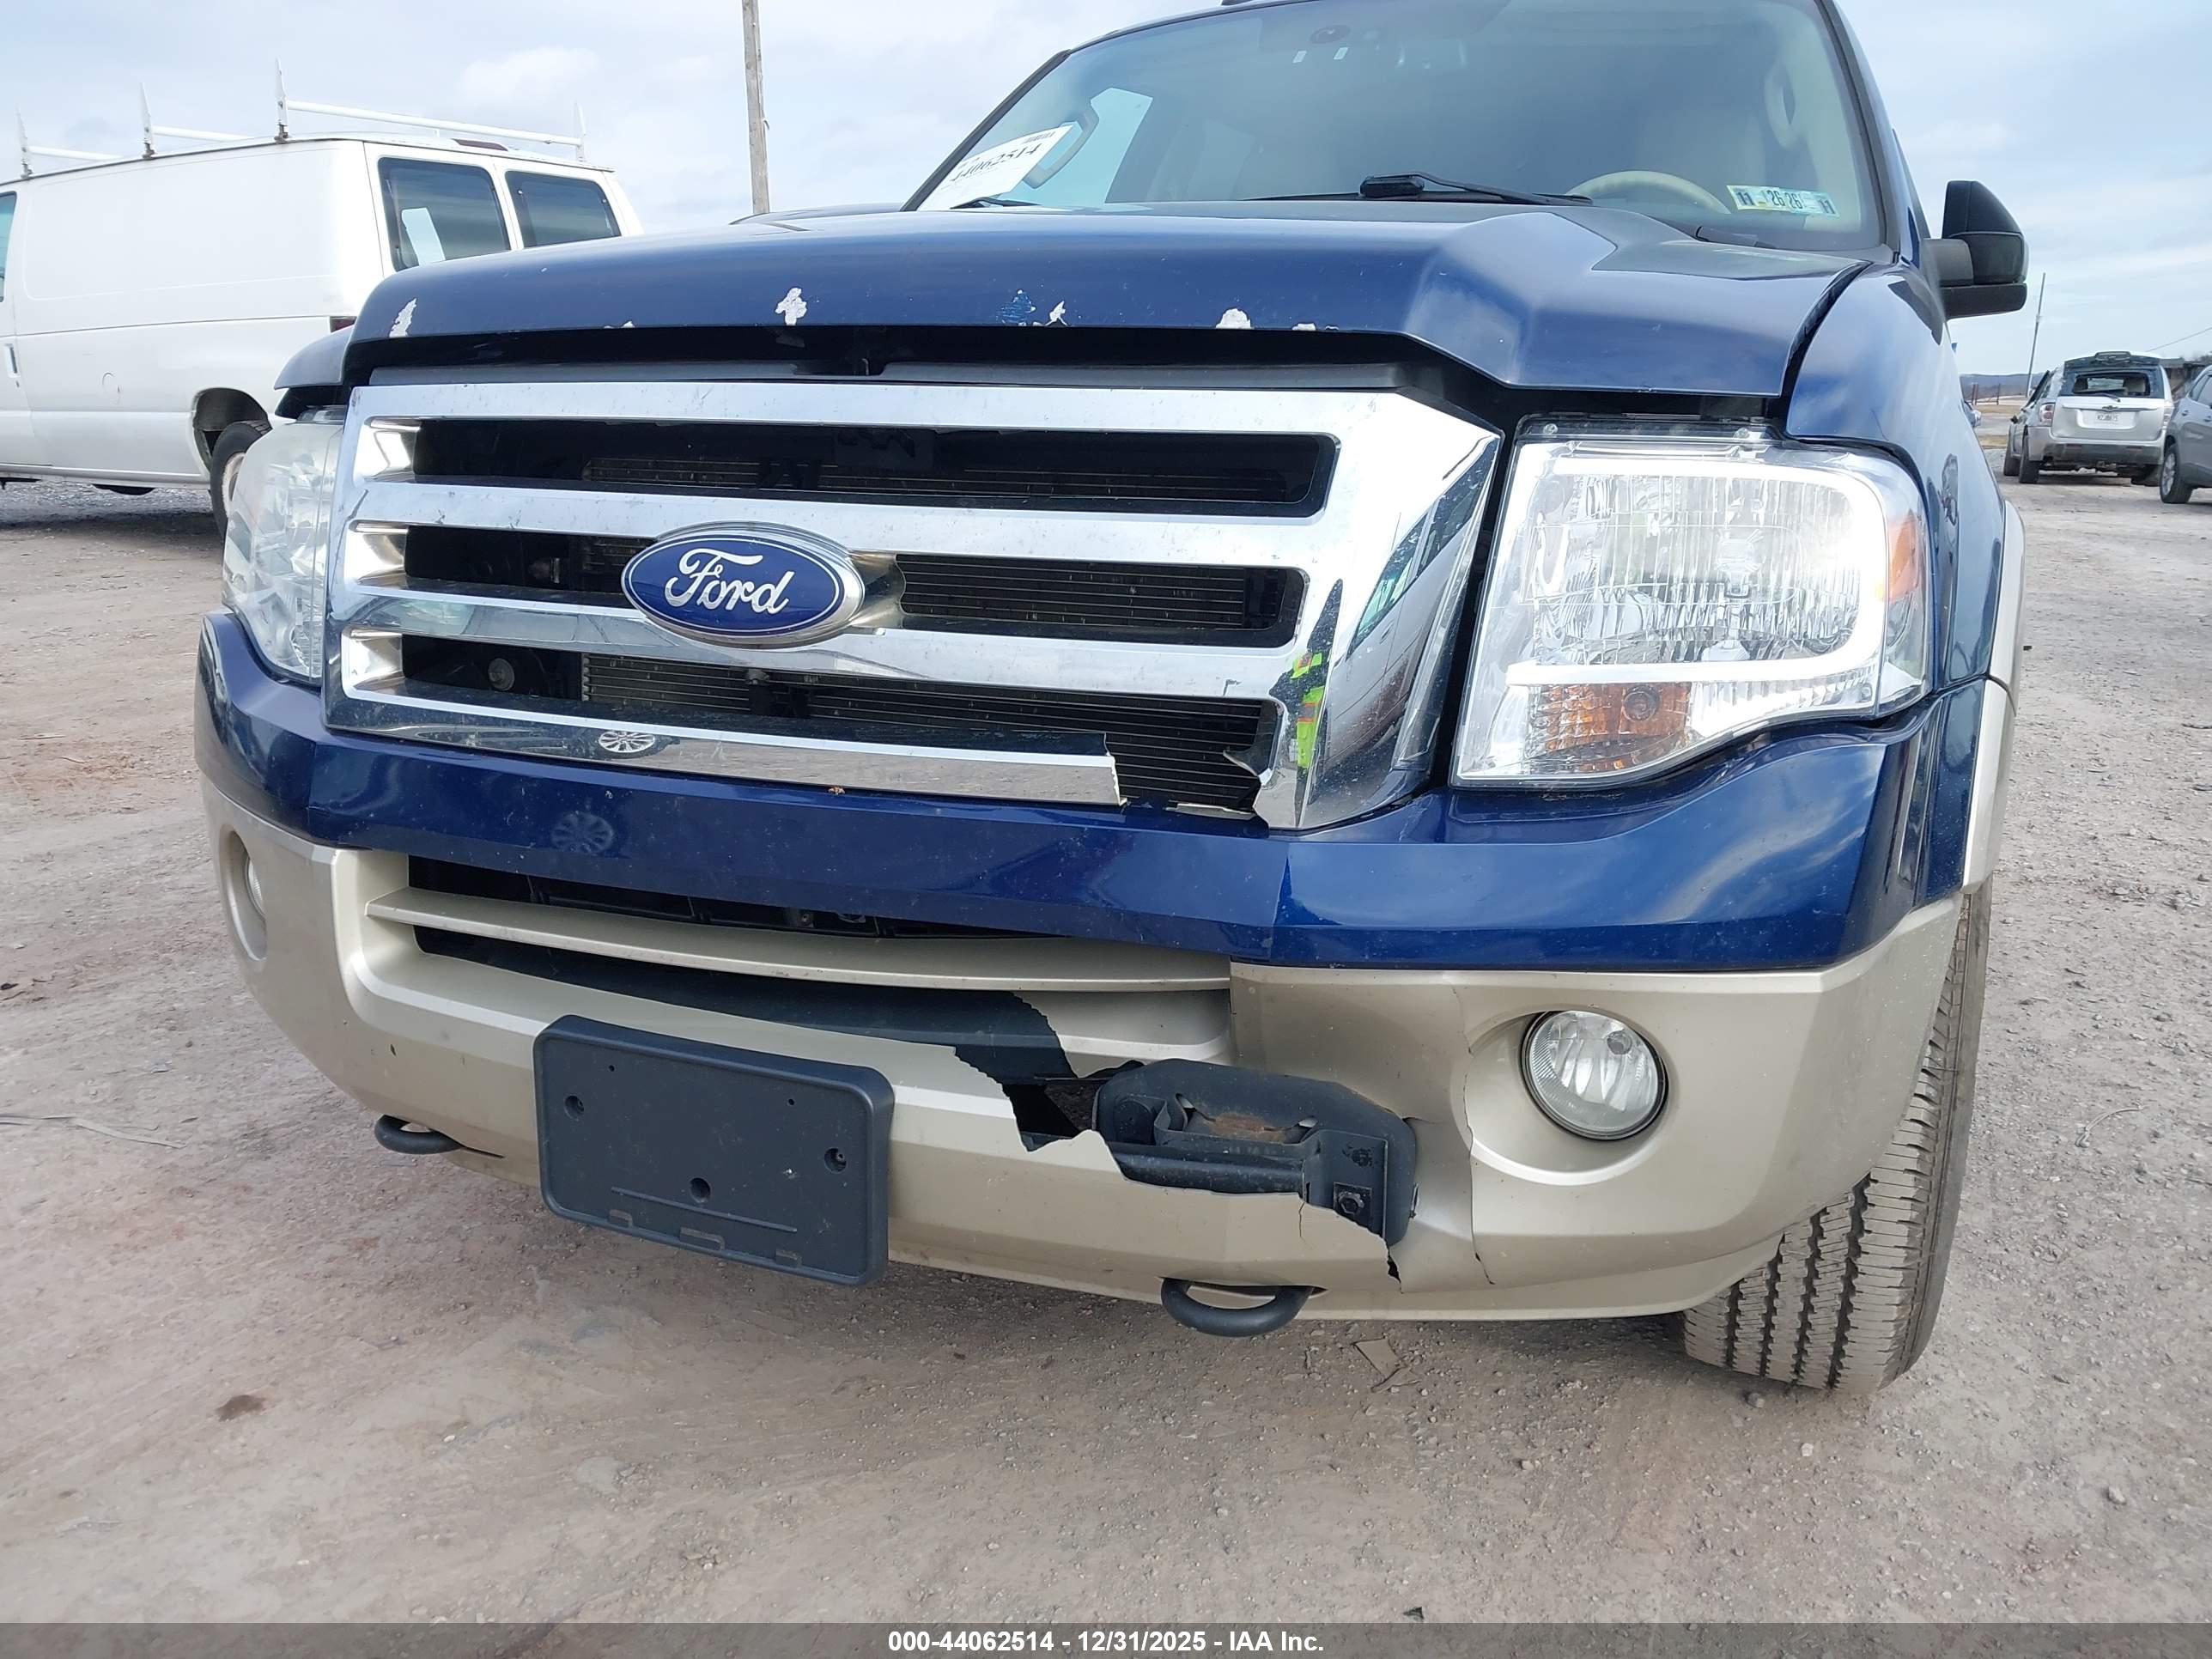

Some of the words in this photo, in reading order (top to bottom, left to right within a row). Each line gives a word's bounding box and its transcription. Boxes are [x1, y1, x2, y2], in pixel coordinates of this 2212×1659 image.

[1766, 190, 1786, 206] 26
[1784, 191, 1803, 210] 26
[665, 548, 795, 615] Ford
